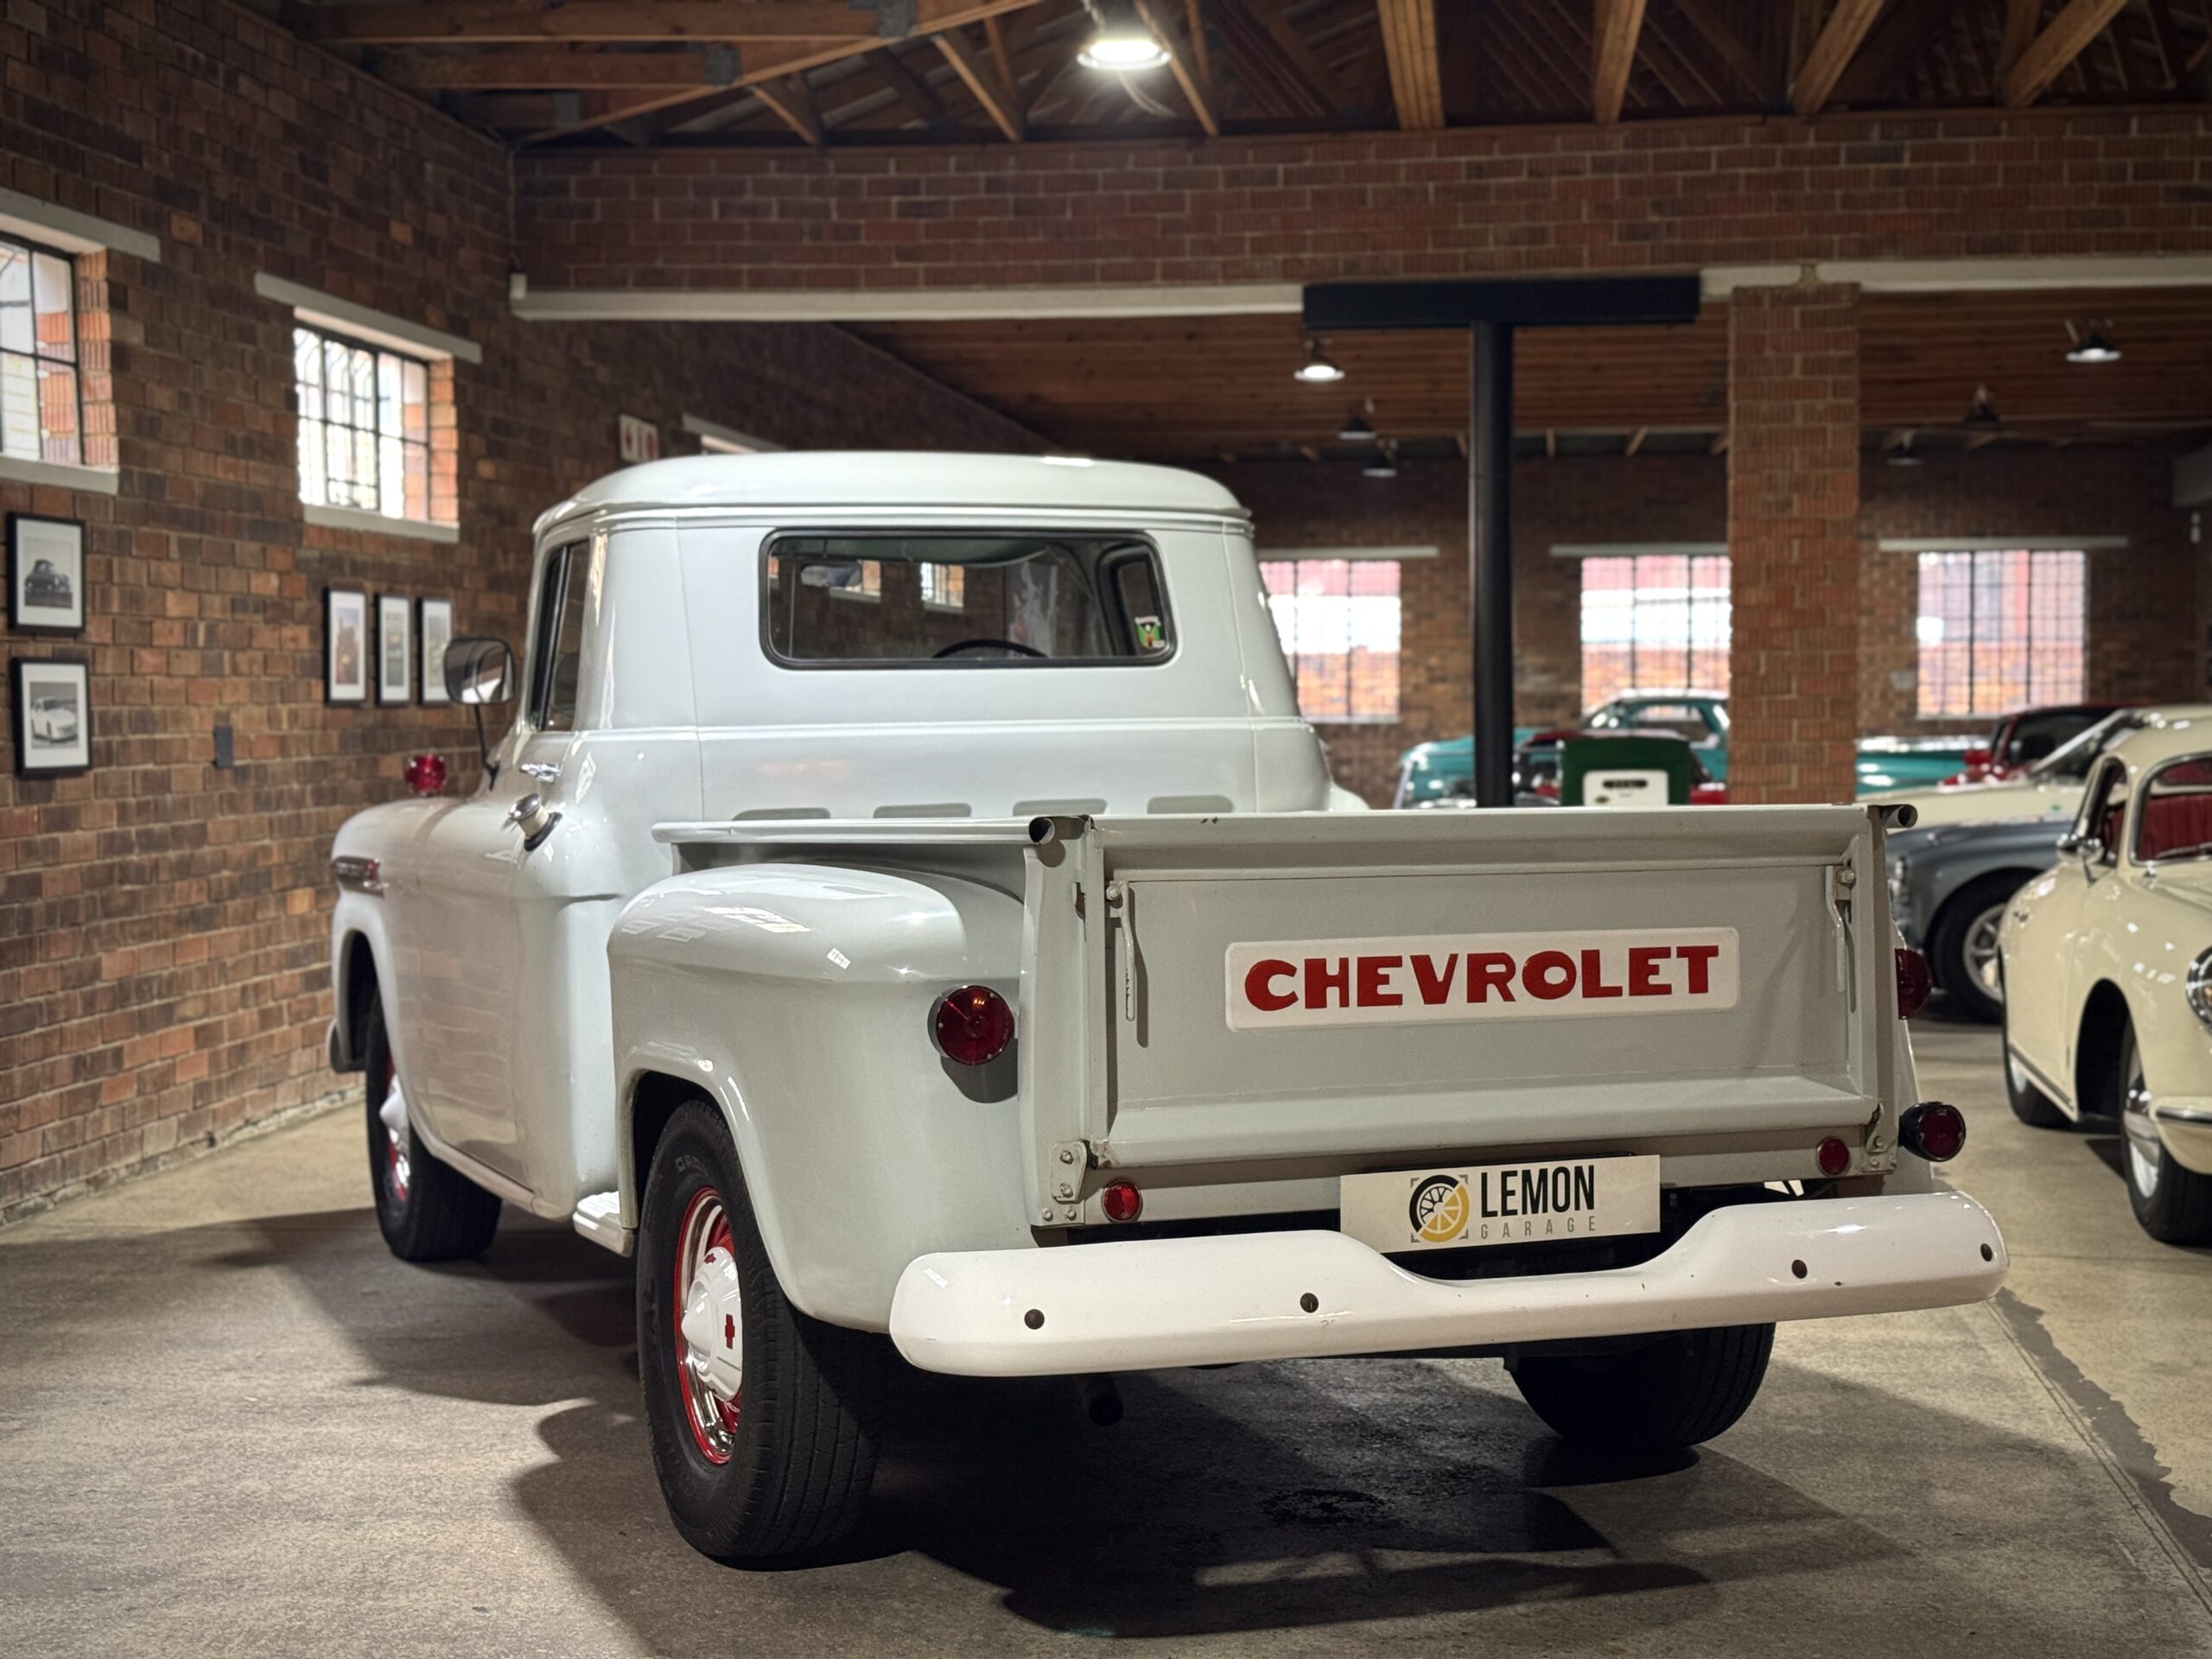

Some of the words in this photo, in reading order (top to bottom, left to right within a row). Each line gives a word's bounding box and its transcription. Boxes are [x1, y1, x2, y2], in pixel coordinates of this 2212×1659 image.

[1244, 944, 1719, 1012] CHEVROLET
[1480, 1165, 1595, 1217] LEMON
[1480, 1216, 1596, 1240] GARAGE
